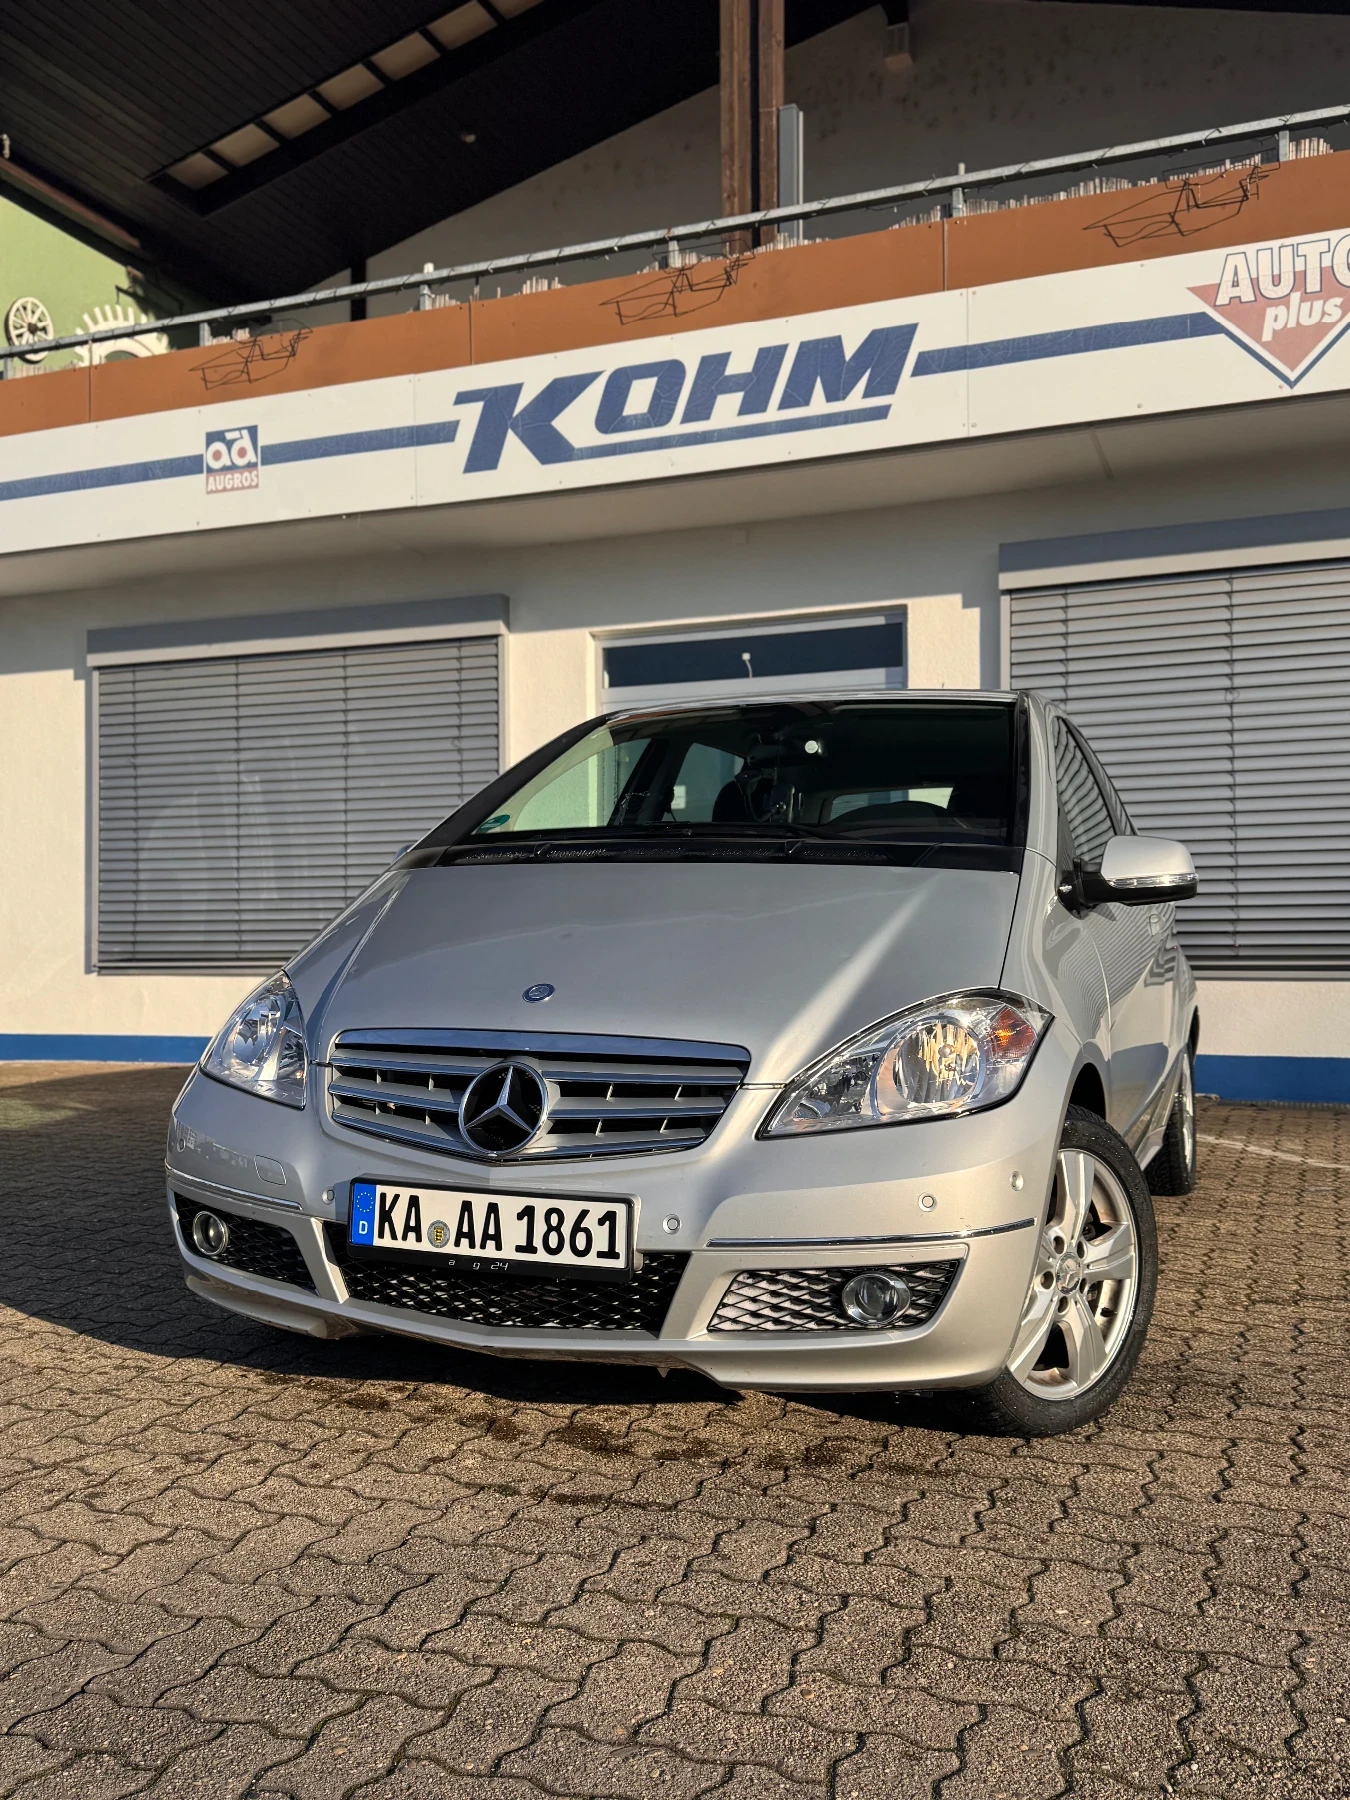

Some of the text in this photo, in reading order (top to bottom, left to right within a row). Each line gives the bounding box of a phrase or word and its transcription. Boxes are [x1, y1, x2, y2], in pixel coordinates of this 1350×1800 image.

[1262, 291, 1344, 342] plus
[453, 322, 919, 473] KOHM
[207, 470, 258, 492] AUGROS
[359, 1220, 368, 1234] D
[378, 1192, 621, 1261] KA AA 1861
